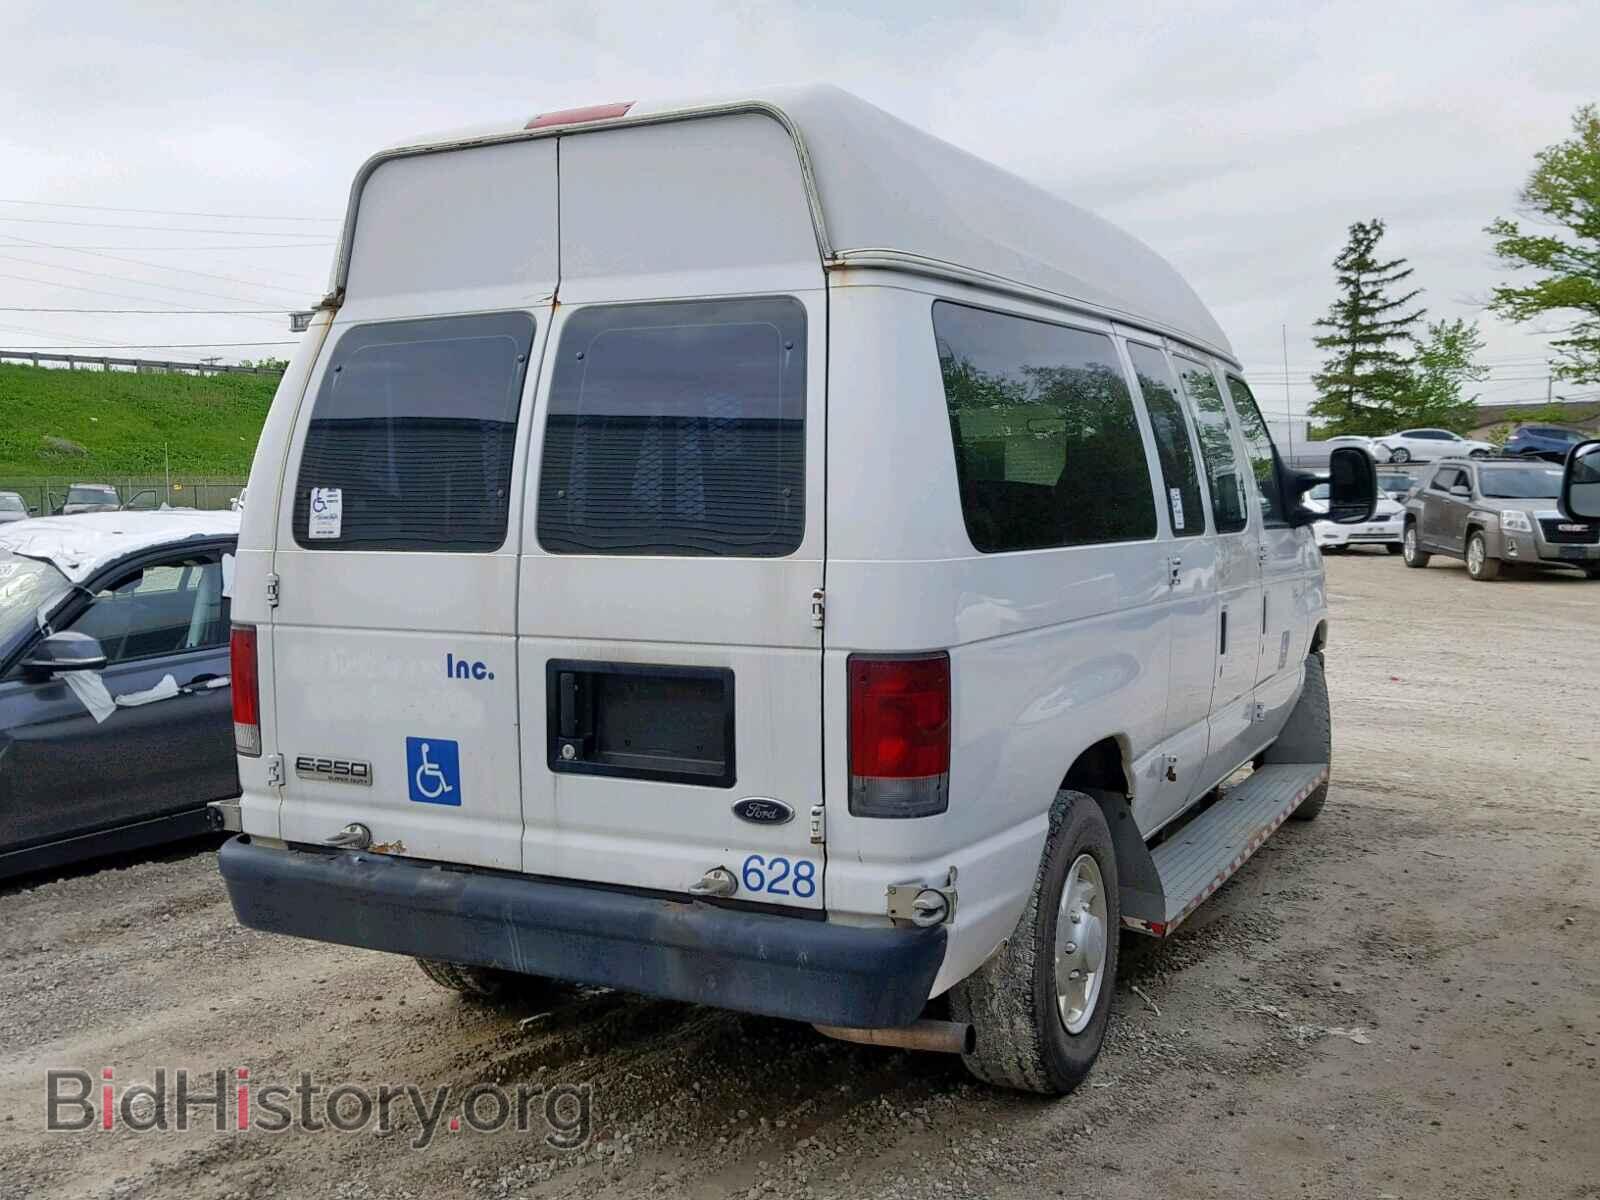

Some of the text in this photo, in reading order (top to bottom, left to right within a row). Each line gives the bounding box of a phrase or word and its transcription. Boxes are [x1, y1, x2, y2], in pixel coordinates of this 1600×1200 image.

[447, 653, 494, 680] Inc.
[745, 802, 778, 819] Ford
[742, 854, 816, 898] 628
